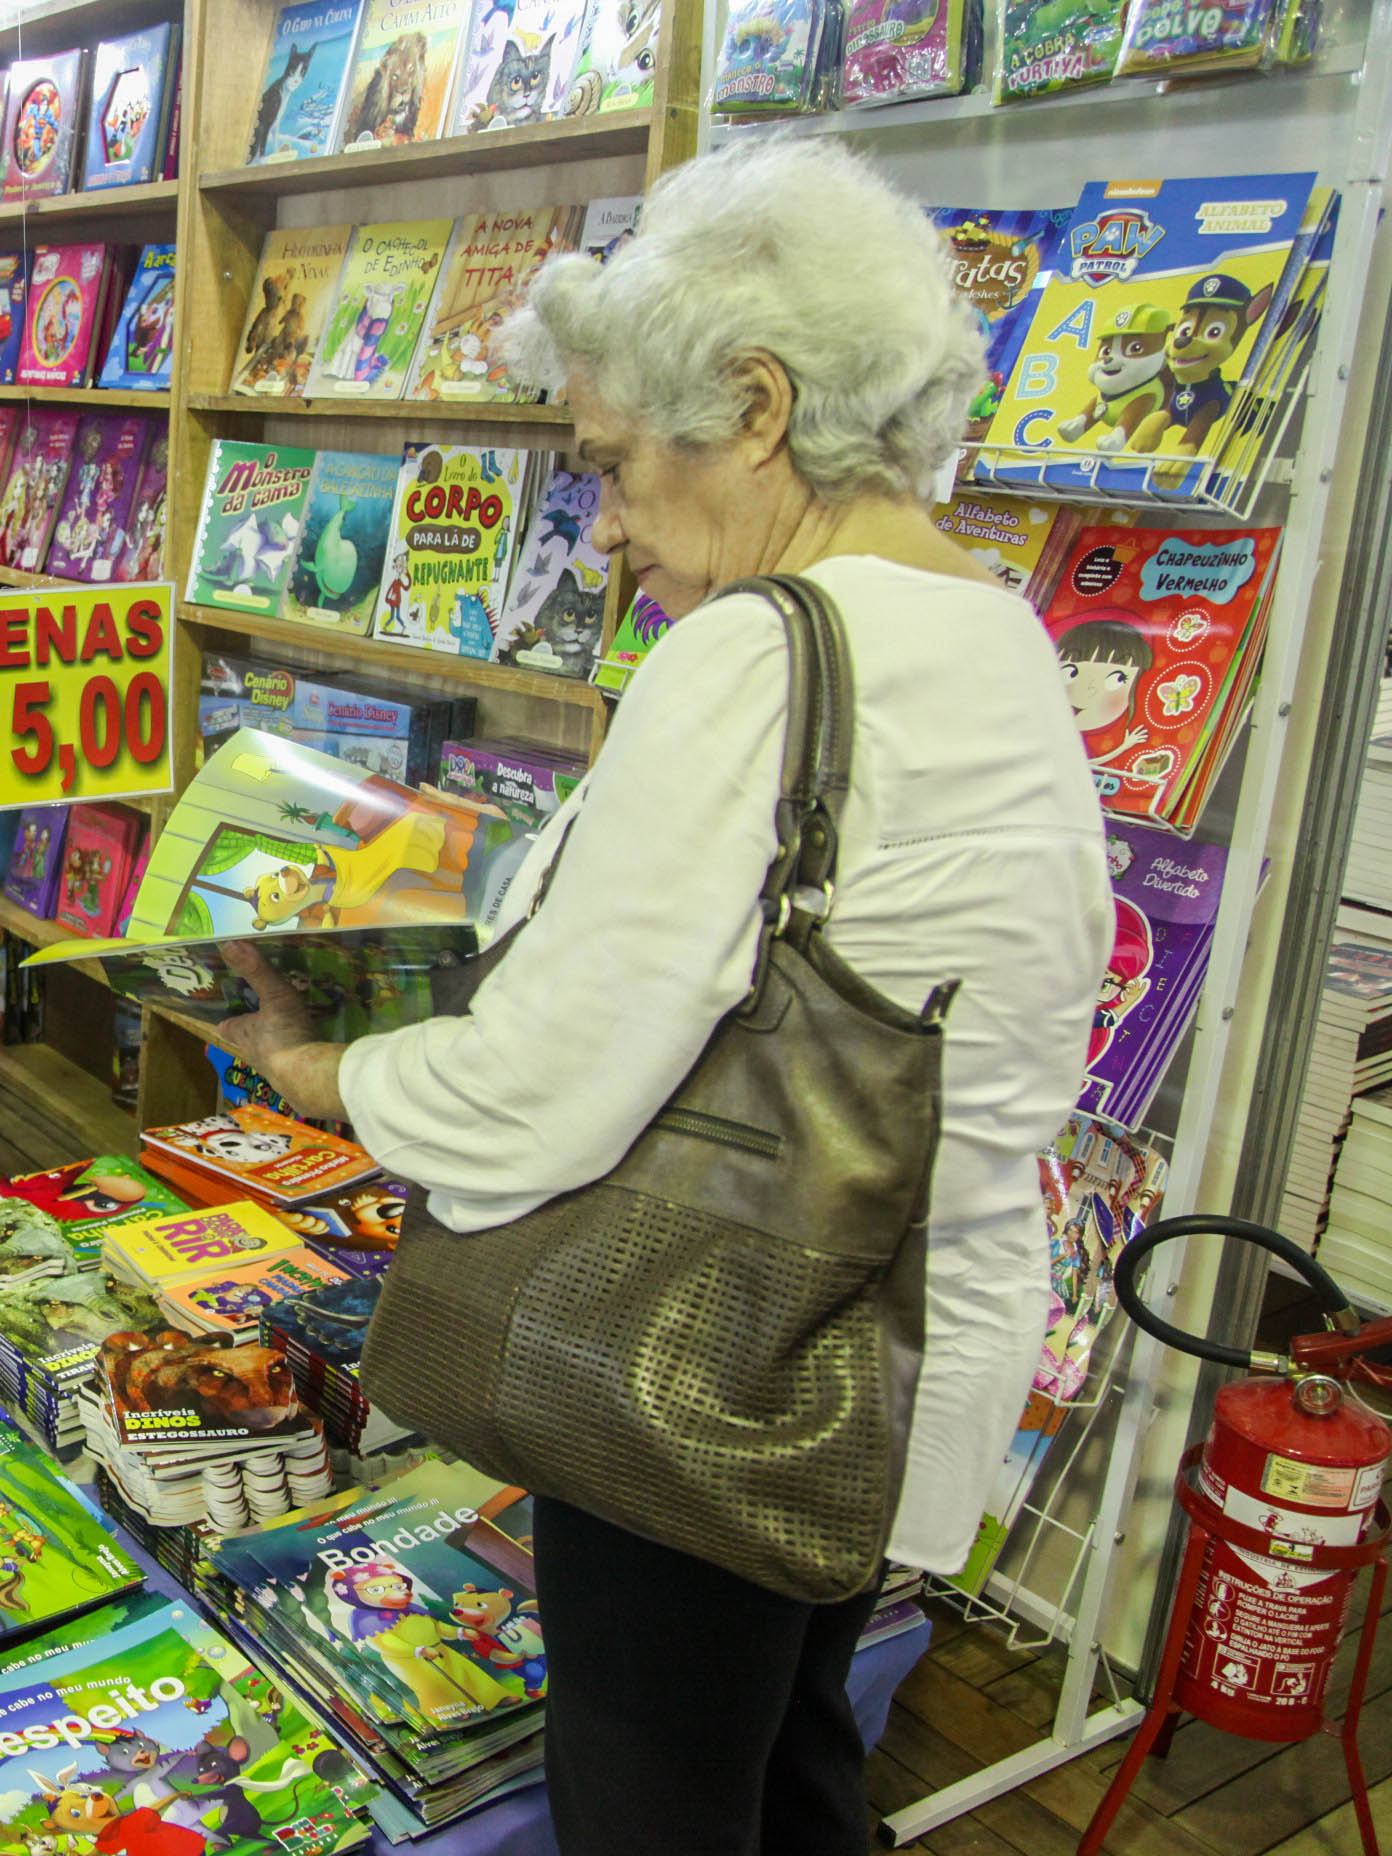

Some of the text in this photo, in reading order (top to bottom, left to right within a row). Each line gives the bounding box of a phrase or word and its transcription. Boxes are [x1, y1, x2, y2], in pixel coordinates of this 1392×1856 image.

[1135, 7, 1224, 48] POLVO
[1010, 33, 1076, 70] A COBRA
[1198, 201, 1285, 219] ALFABETO
[475, 215, 533, 234] A NOVA
[1199, 217, 1270, 233] ANIMAL
[362, 237, 374, 253] O
[460, 239, 534, 258] AMIGA DE
[1071, 221, 1166, 259] PAW
[364, 260, 379, 274] DE
[464, 265, 515, 288] TITA
[1078, 261, 1128, 274] PATROL
[1047, 299, 1096, 349] A
[1015, 352, 1059, 401] B
[1013, 409, 1055, 453] C
[217, 460, 312, 497] Monstro
[443, 467, 478, 483] Livro do
[221, 481, 303, 516] da cama
[406, 484, 504, 529] CORPO
[953, 502, 1020, 528] Alfabeto
[412, 529, 477, 549] PARA LÁ DE
[935, 515, 1028, 547] de Aventuras
[412, 557, 490, 586] REPUGNANTE
[245, 671, 287, 691] Cenário
[251, 688, 290, 712] Disney
[327, 701, 399, 723] Cenário Disney
[10, 671, 166, 793] 5,00
[497, 762, 533, 785] Descubra
[491, 782, 535, 805] a natureza
[1151, 857, 1209, 883] Alfabeto
[1142, 874, 1200, 899] Divertido
[261, 1150, 337, 1180] Cartilha
[154, 1218, 233, 1264] RIR
[37, 1341, 96, 1365] Incríveis
[46, 1346, 102, 1372] DINOS
[123, 1408, 195, 1420] Incríveis
[125, 1415, 201, 1430] DINOS
[127, 1427, 249, 1441] ESTEGOSSAURO
[317, 1501, 429, 1545] O que cabe no meu mundo
[316, 1506, 480, 1572] Bondade
[0, 1644, 70, 1676] cabe no meu
[6, 1691, 36, 1714] cabe
[37, 1688, 54, 1701] no
[56, 1682, 82, 1696] meu
[84, 1675, 132, 1689] mundo
